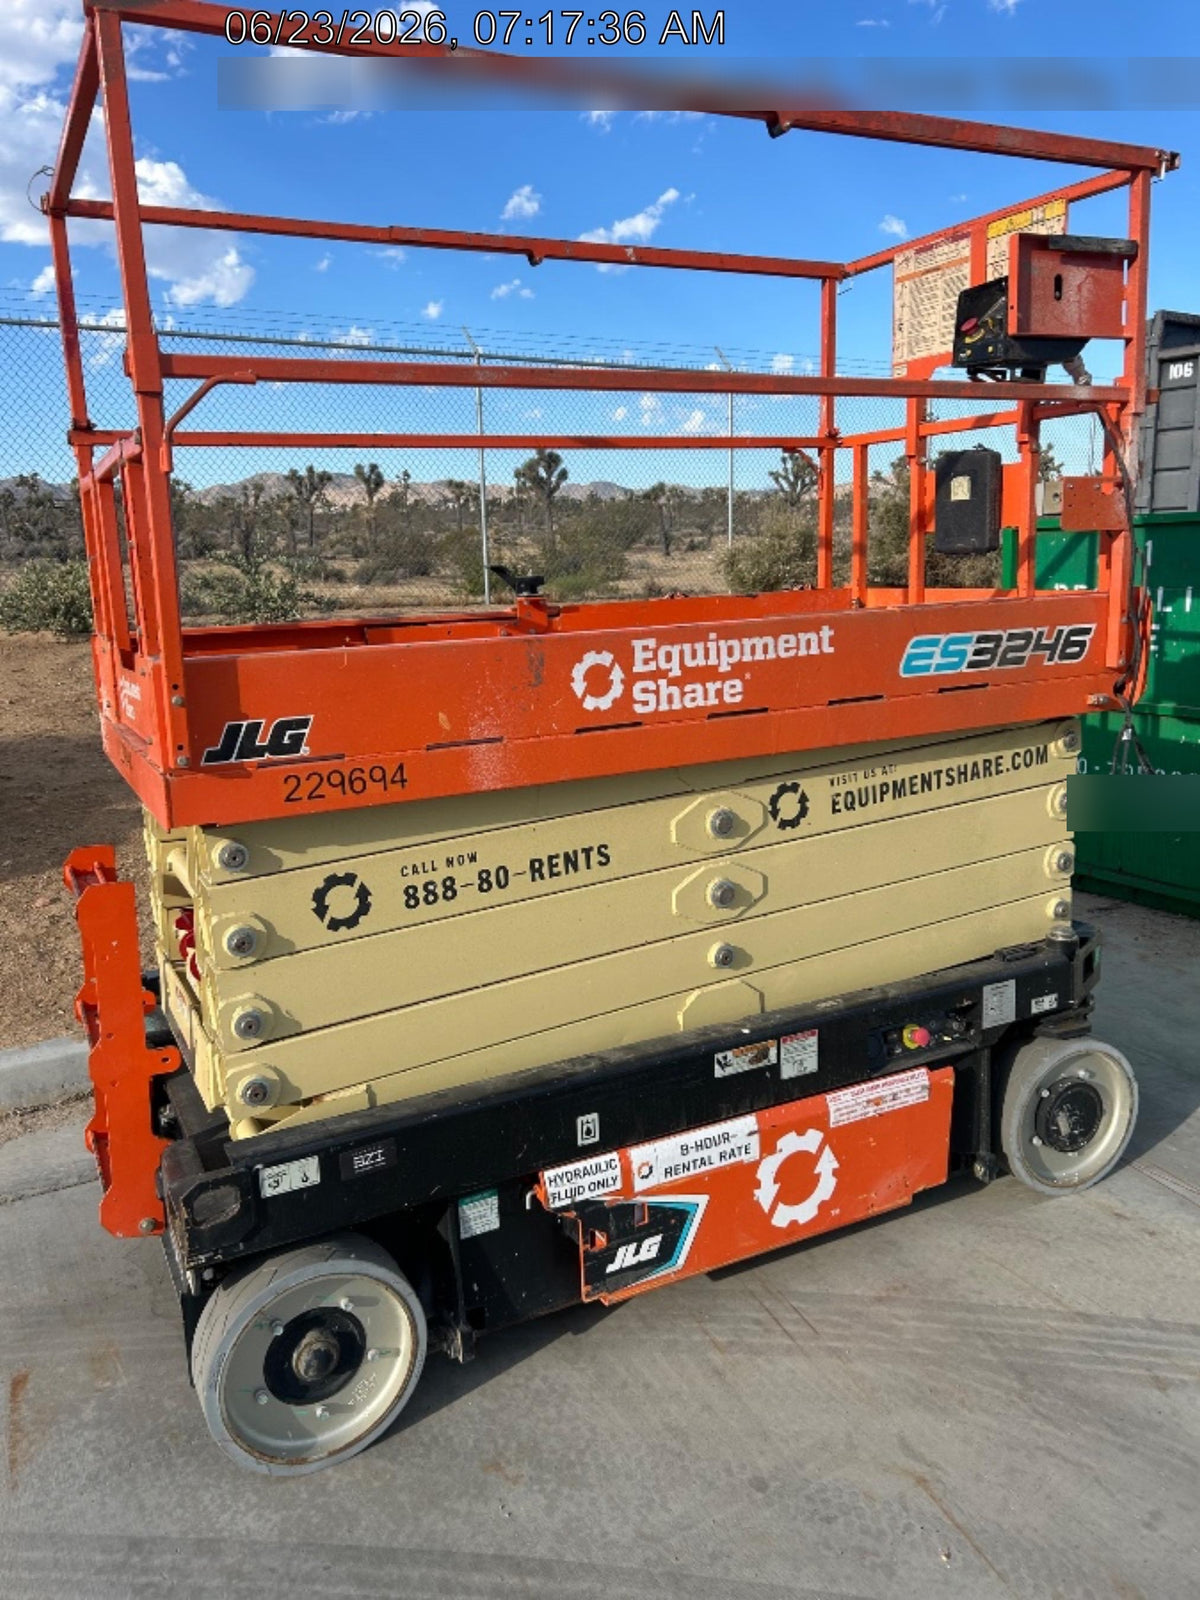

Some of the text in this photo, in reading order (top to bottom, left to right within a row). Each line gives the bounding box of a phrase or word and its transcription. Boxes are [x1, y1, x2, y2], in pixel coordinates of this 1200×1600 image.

[1169, 361, 1195, 380] 106
[631, 625, 835, 678] Equipment
[899, 623, 1097, 678] ES3246
[632, 677, 744, 714] Share
[201, 714, 314, 766] JLG
[283, 762, 408, 803] 229694
[829, 772, 857, 787] VISIT
[863, 767, 877, 780] US
[831, 744, 1048, 815] EQUIPMENTSHARE.COM
[400, 851, 478, 878] CALL NOW
[547, 1158, 618, 1187] HYDRAULIC
[664, 1142, 752, 1180] RENTAL RATE
[550, 1174, 618, 1206] FLUID ONLY
[605, 1232, 664, 1274] JLG
